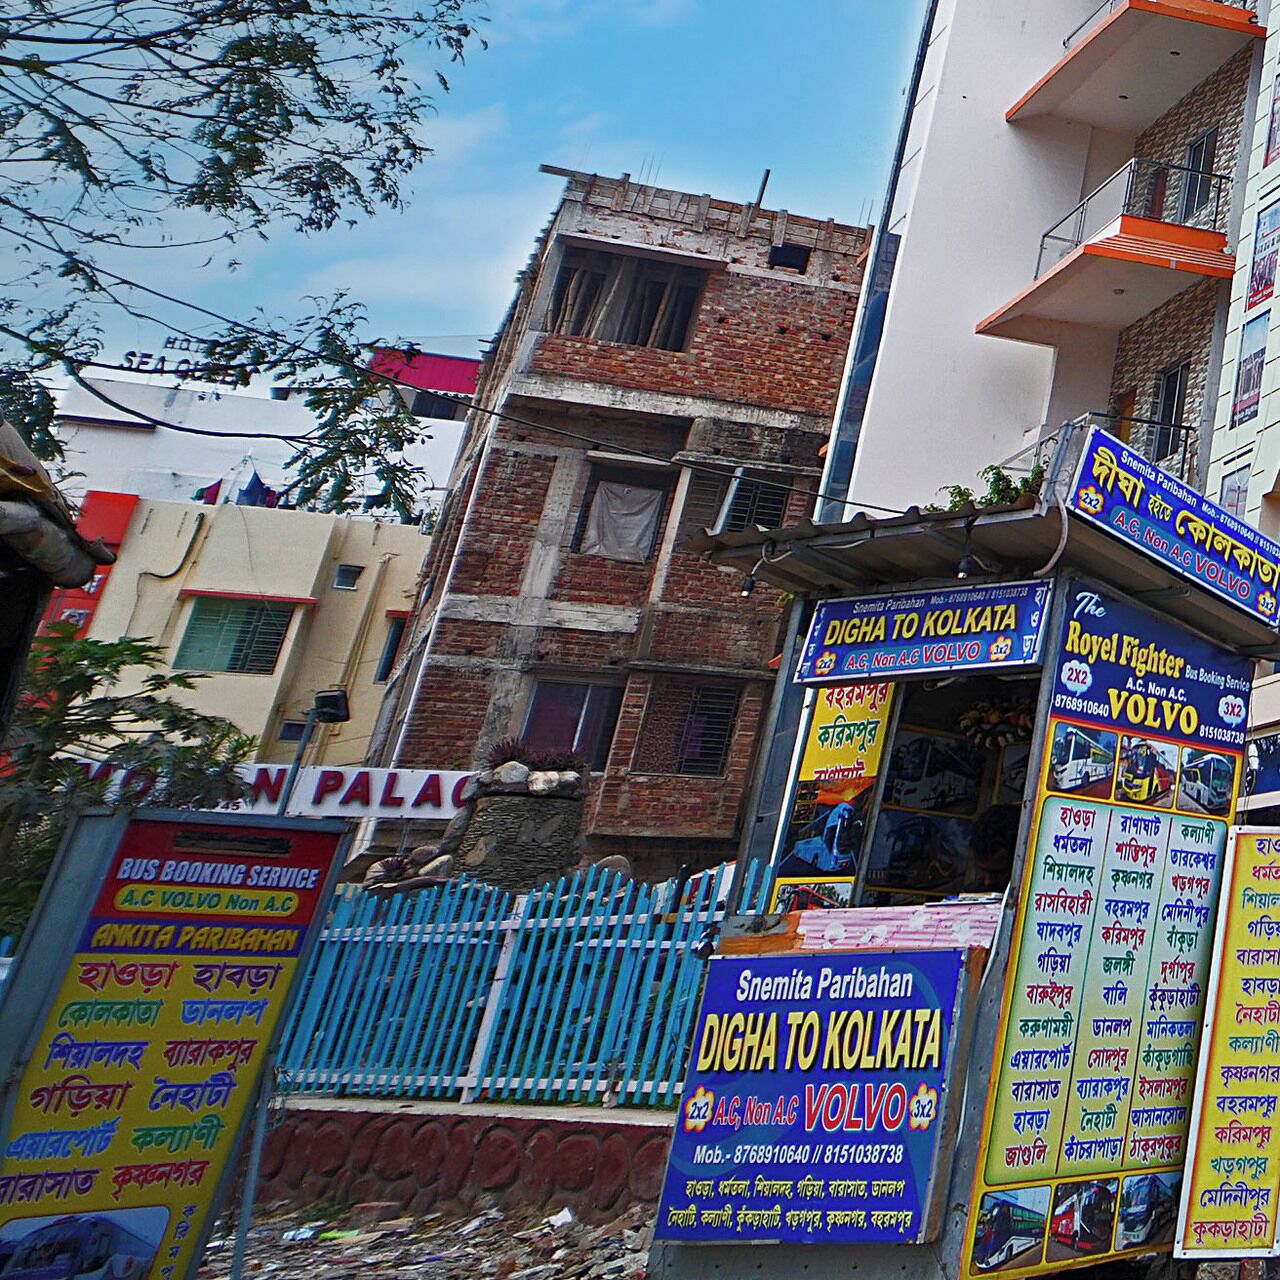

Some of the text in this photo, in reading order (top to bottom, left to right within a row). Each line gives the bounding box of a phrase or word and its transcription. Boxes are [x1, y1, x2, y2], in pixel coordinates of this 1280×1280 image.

[1092, 446, 1146, 508] দীঘা
[1147, 492, 1174, 522] হইতে
[1120, 449, 1156, 482] Snemita
[1156, 472, 1198, 508] Paribahan
[1114, 510, 1141, 540] A.C,
[1143, 527, 1169, 554] Non
[1171, 542, 1192, 566] A.C
[1195, 553, 1252, 600] VOLVO
[852, 602, 884, 614] Snemita
[884, 597, 926, 611] Paribahan
[1073, 591, 1108, 619] The
[823, 612, 887, 647] DIGHA
[891, 611, 919, 641] TO
[920, 603, 1017, 639] KOLKATA
[872, 651, 897, 668] Non
[898, 648, 919, 666] A.C
[922, 640, 982, 664] VOLVO
[1065, 620, 1250, 692] Royel Fighter Bus Booking Service
[1066, 666, 1243, 718] 2X2 A.C. Non A.C. 3X2
[1054, 687, 1245, 745] 8768910640 VOLVO 8151038738
[816, 714, 881, 753] করিমপুর
[1059, 806, 1097, 832] হাওড়া
[1120, 814, 1162, 837] রাণাঘাট
[1180, 821, 1216, 846] কল্যাণী
[1053, 828, 1094, 857] ধর্মতলা
[116, 858, 321, 890] BUS BOOKING SERVICE
[1042, 854, 1096, 886] শিয়ালদহ
[1170, 848, 1217, 871] তারকেশ্বর
[1111, 867, 1155, 893] কৃষ্ণনগর
[1171, 875, 1211, 901] খড়গপুর
[120, 888, 296, 913] A.C VOLVO Non A.C
[1034, 887, 1094, 916] রাসবিহারী
[1104, 898, 1151, 925] বহরমপুর
[1161, 897, 1211, 929] মেদিনীপুর
[90, 922, 300, 953] ANKITA PARIBAHAN
[1036, 921, 1083, 948] যাদবপুর
[1101, 920, 1147, 951] করিমপুর
[1166, 924, 1199, 955] বাঁকুড়া
[1037, 946, 1072, 977] গড়িয়া
[1102, 949, 1136, 977] জলঙ্গী
[1160, 952, 1196, 986] দুর্গাপুর
[78, 959, 285, 995] হাওড়া হাবড়া
[735, 965, 914, 1003] Snemita Paribahan
[1102, 979, 1129, 1007] বালি
[57, 997, 271, 1029] কোলকাতা ডানলপ
[1019, 1011, 1075, 1039] করুণাময়ী
[1092, 1017, 1133, 1038] ডানলপ
[1146, 1014, 1198, 1040] মানিকতলা
[43, 1030, 259, 1074] শিয়ালদহ ব্যারাকপুর
[695, 1008, 943, 1073] DIGHA TO KOLKATA
[1010, 1041, 1073, 1071] এয়ারপোর্ট
[1087, 1047, 1130, 1073] সোদপুর
[1142, 1041, 1195, 1073] কাঁকুড়গাছি
[29, 1069, 239, 1119] গড়িয়া নৈহাটী
[1011, 1079, 1062, 1103] বারাসাত
[1076, 1076, 1131, 1102] ব্যারাকপুর
[1138, 1076, 1189, 1102] ইসলামপুর
[689, 1082, 934, 1132] 2x2 A.C, Non A.C VOLVO 3x2
[1080, 1102, 1118, 1133] নৈহাটী
[1130, 1106, 1188, 1128] আসানসোল
[1216, 1094, 1279, 1118] বহরমপুর
[3, 1112, 226, 1162] এয়ারপোর্ট কল্যাণী
[1013, 1109, 1051, 1135] হাবড়া
[1215, 1119, 1273, 1150] করিমপুর
[693, 1144, 904, 1165] Mob.- 8768910640 8151038738
[1064, 1134, 1124, 1164] কাঁচরাপাড়া
[1129, 1129, 1184, 1161] ঠাকুরপুকুর
[110, 1158, 211, 1202] কৃষ্ণনগর
[1210, 1156, 1270, 1181] খড়গপুর
[871, 1178, 906, 1199] ডানলপ
[1199, 1180, 1272, 1213] মেদিনীপুর
[870, 1208, 914, 1233] বহরমপুর
[1192, 1213, 1270, 1245] কুকড়াহাটী
